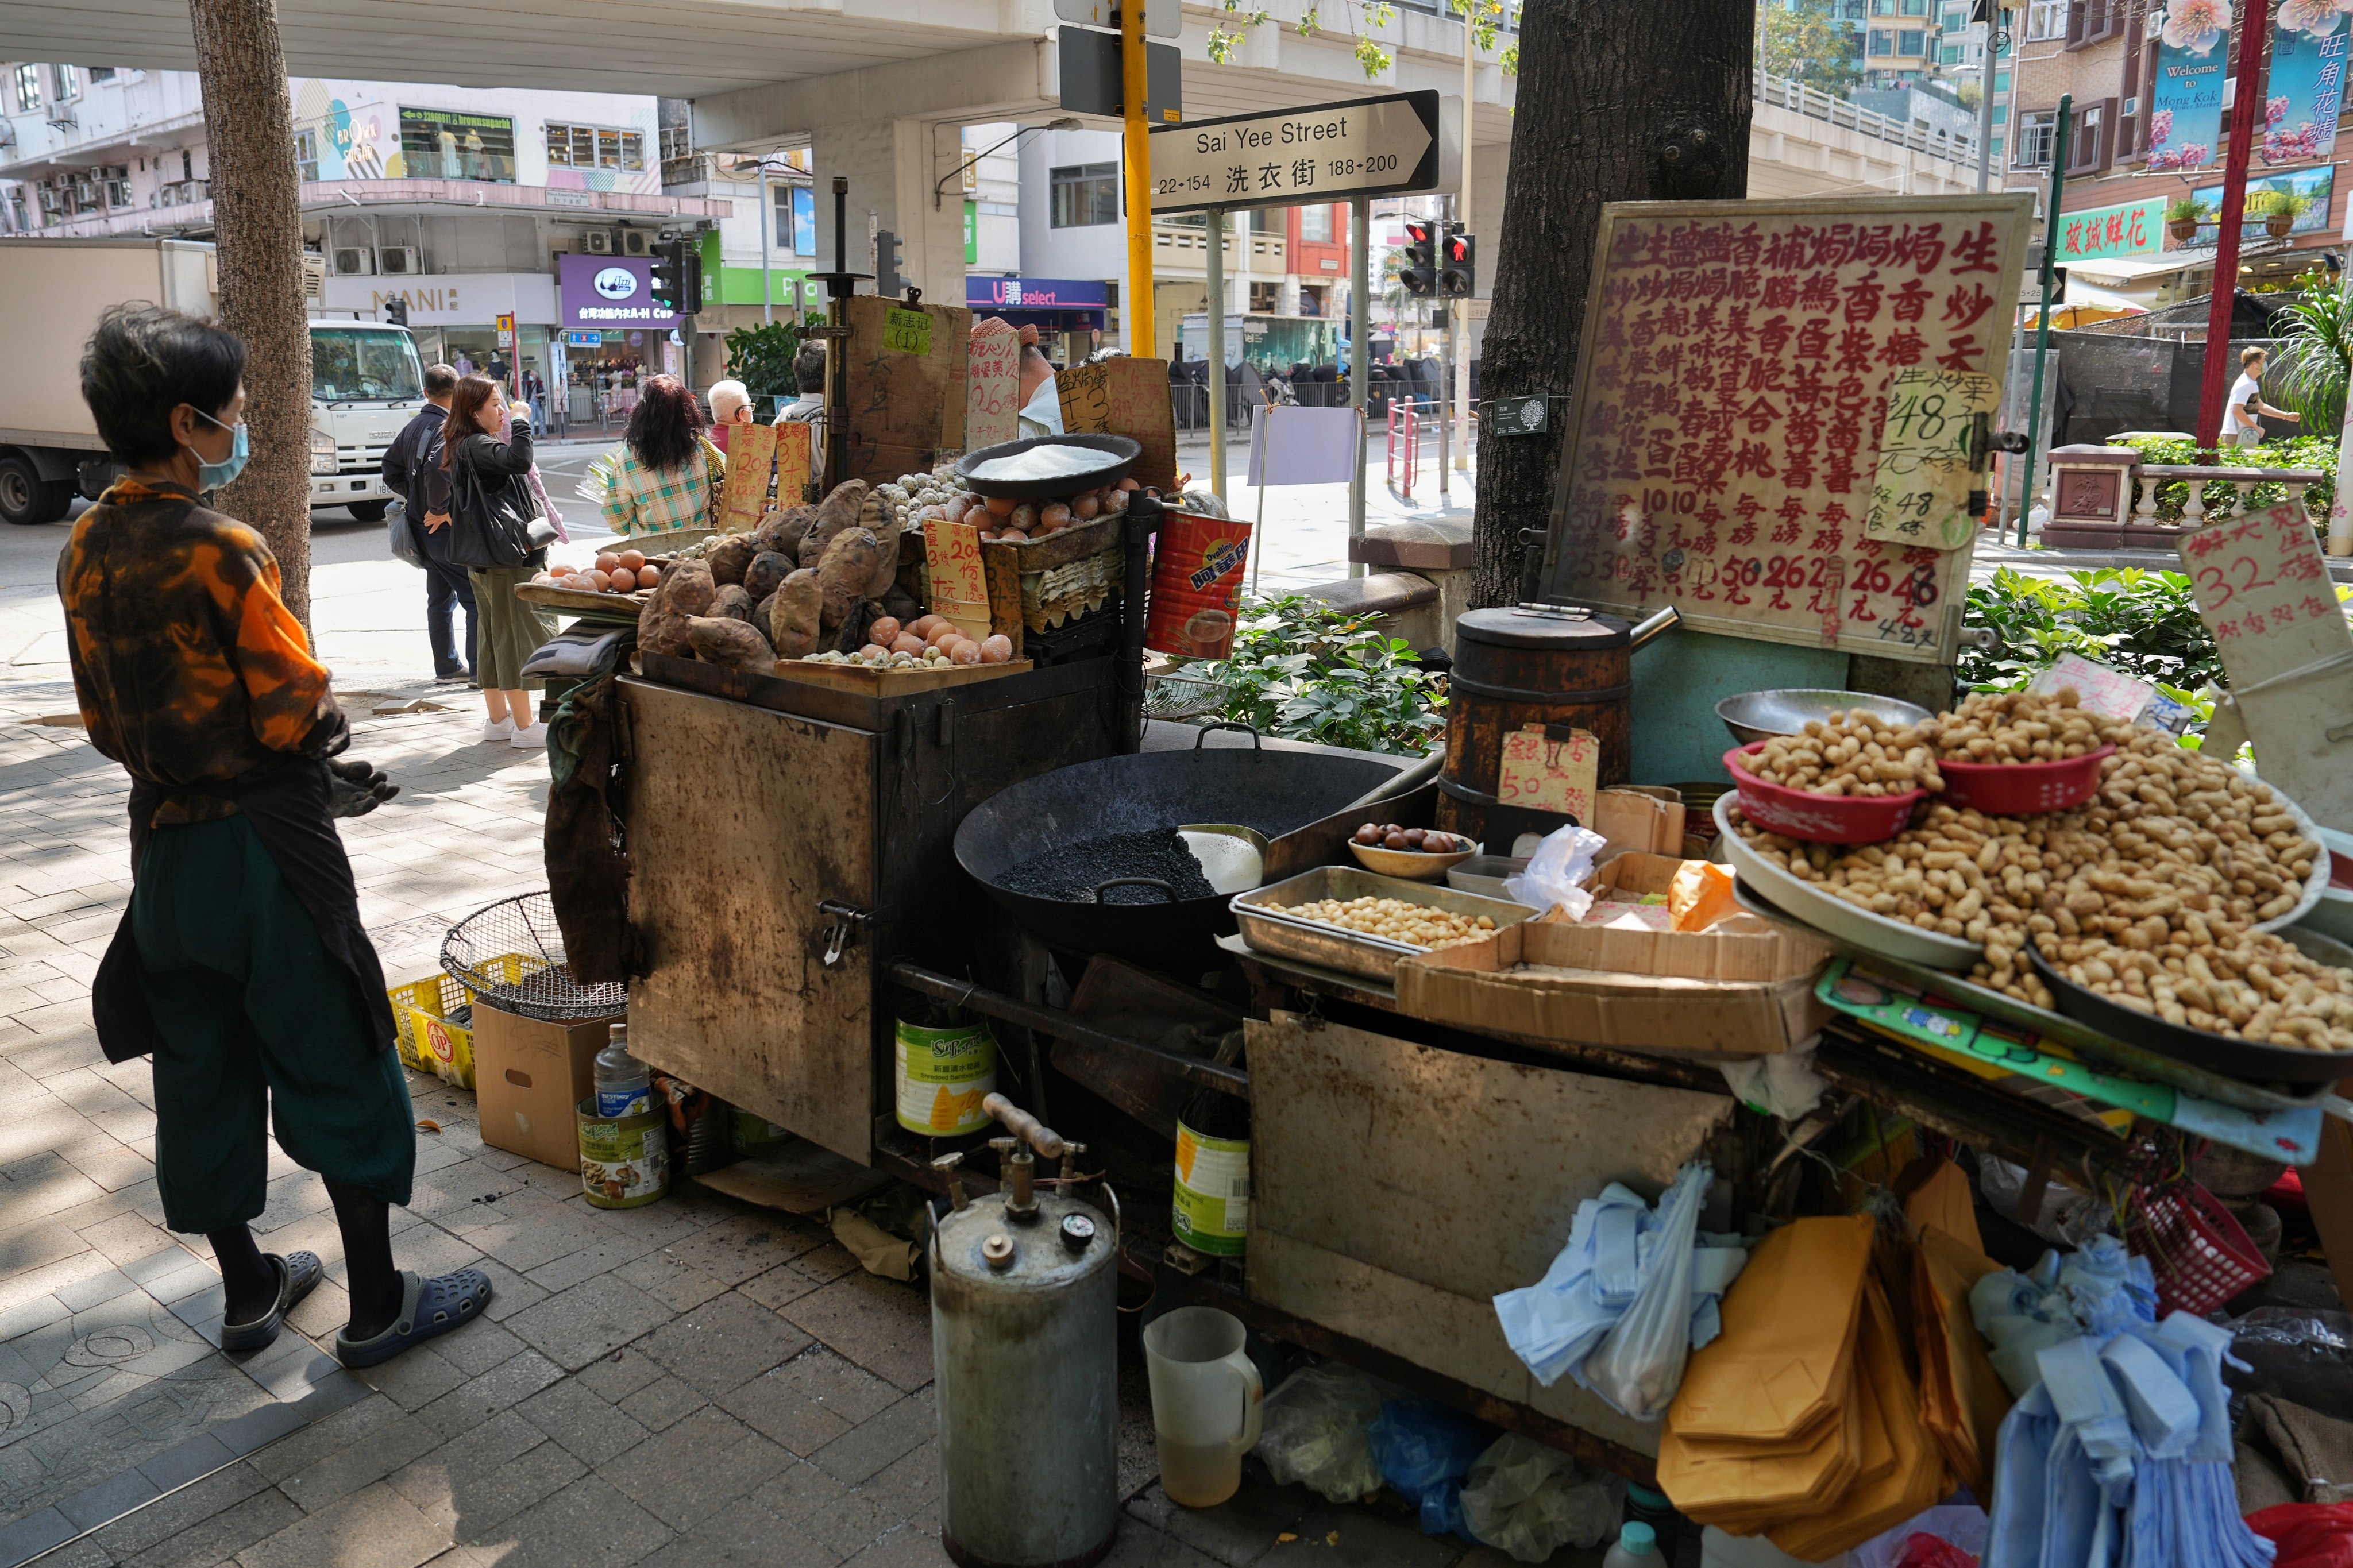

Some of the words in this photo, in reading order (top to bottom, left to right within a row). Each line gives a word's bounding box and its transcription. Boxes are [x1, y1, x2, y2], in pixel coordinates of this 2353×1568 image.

[2167, 64, 2219, 77] Welcome
[2185, 80, 2197, 88] to
[2157, 96, 2190, 107] Mong
[2193, 91, 2217, 103] Kok
[1197, 132, 1226, 154] Sai
[1235, 128, 1272, 149] Yee
[1281, 117, 1347, 144] Street
[343, 145, 373, 163] SUGAR
[1226, 159, 1316, 194] 洗衣街
[1022, 290, 1056, 306] select
[653, 308, 674, 319] Cup
[890, 311, 929, 331] 新志记
[895, 330, 919, 350] (1)
[369, 431, 396, 439] ISUZU
[1206, 542, 1233, 562] Ovaltine
[932, 576, 958, 601] 十元
[920, 1072, 948, 1080] Shredded
